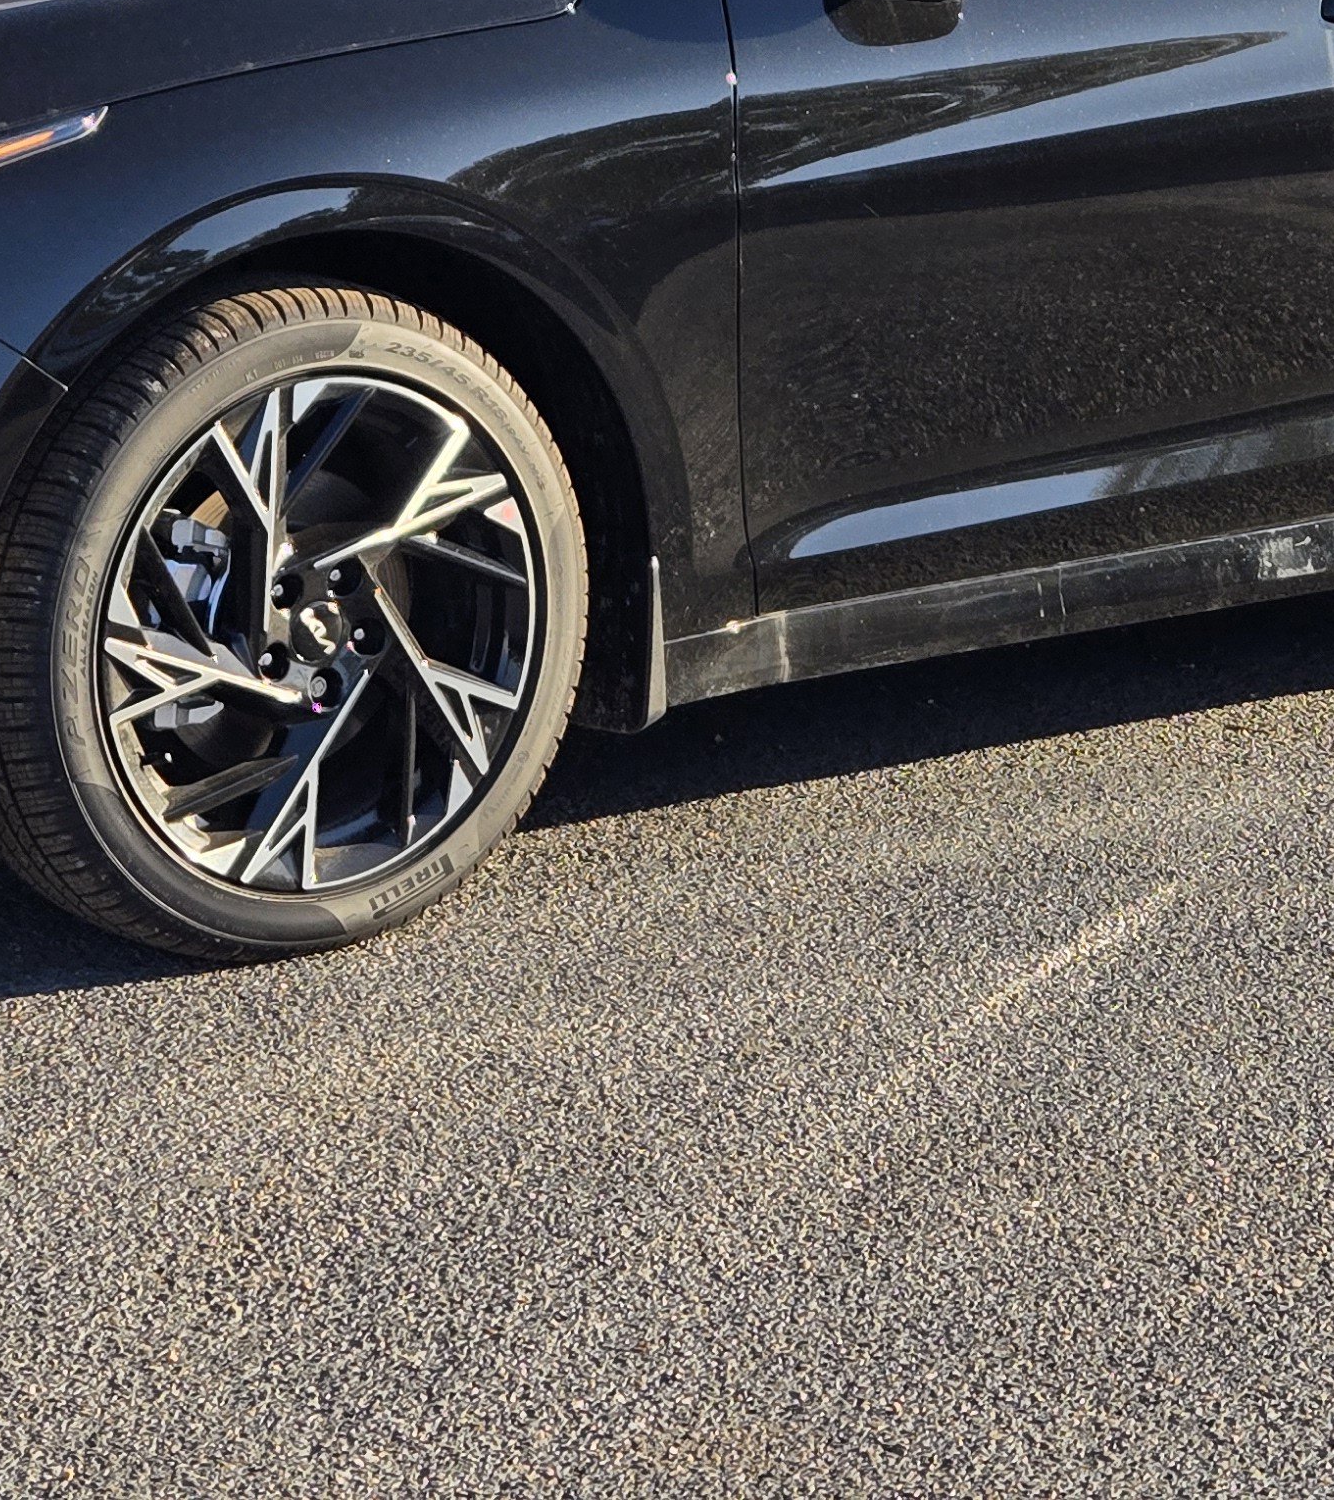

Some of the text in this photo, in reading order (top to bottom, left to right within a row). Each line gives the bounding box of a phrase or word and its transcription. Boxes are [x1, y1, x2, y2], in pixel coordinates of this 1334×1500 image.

[384, 342, 472, 386] 235/45
[60, 555, 91, 705] ZERO
[368, 852, 455, 920] PIRELLI
